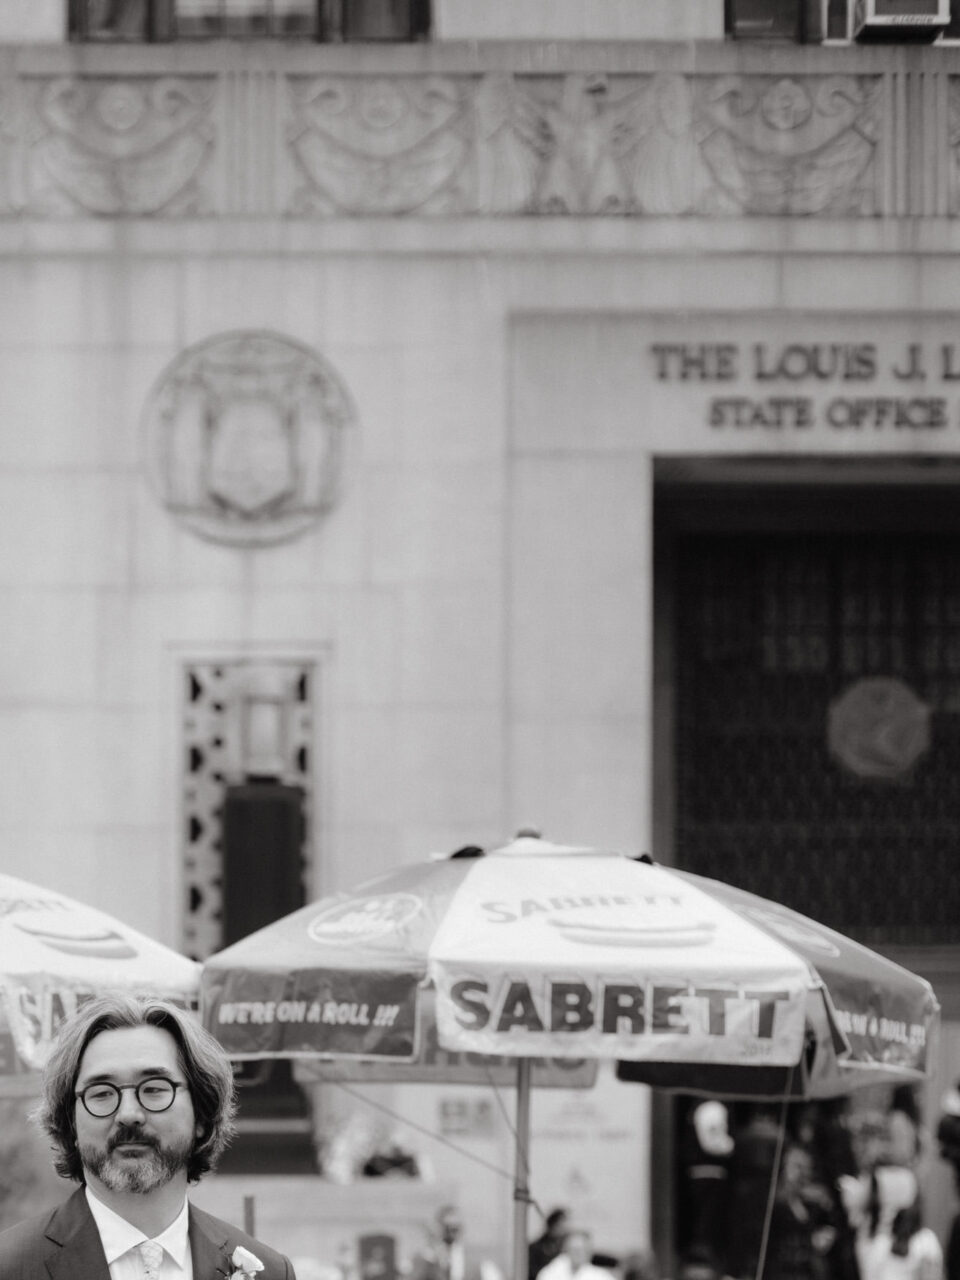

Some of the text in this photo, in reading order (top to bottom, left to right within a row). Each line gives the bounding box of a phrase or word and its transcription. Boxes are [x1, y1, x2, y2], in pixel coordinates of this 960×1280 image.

[650, 343, 738, 380] THE
[754, 343, 876, 381] LOUIS
[893, 343, 926, 380] J.
[709, 398, 946, 427] STATE OFFICE
[276, 1001, 306, 1024] ON
[306, 1002, 321, 1024] A
[322, 1002, 370, 1026] ROLL
[450, 980, 790, 1040] SABRETT
